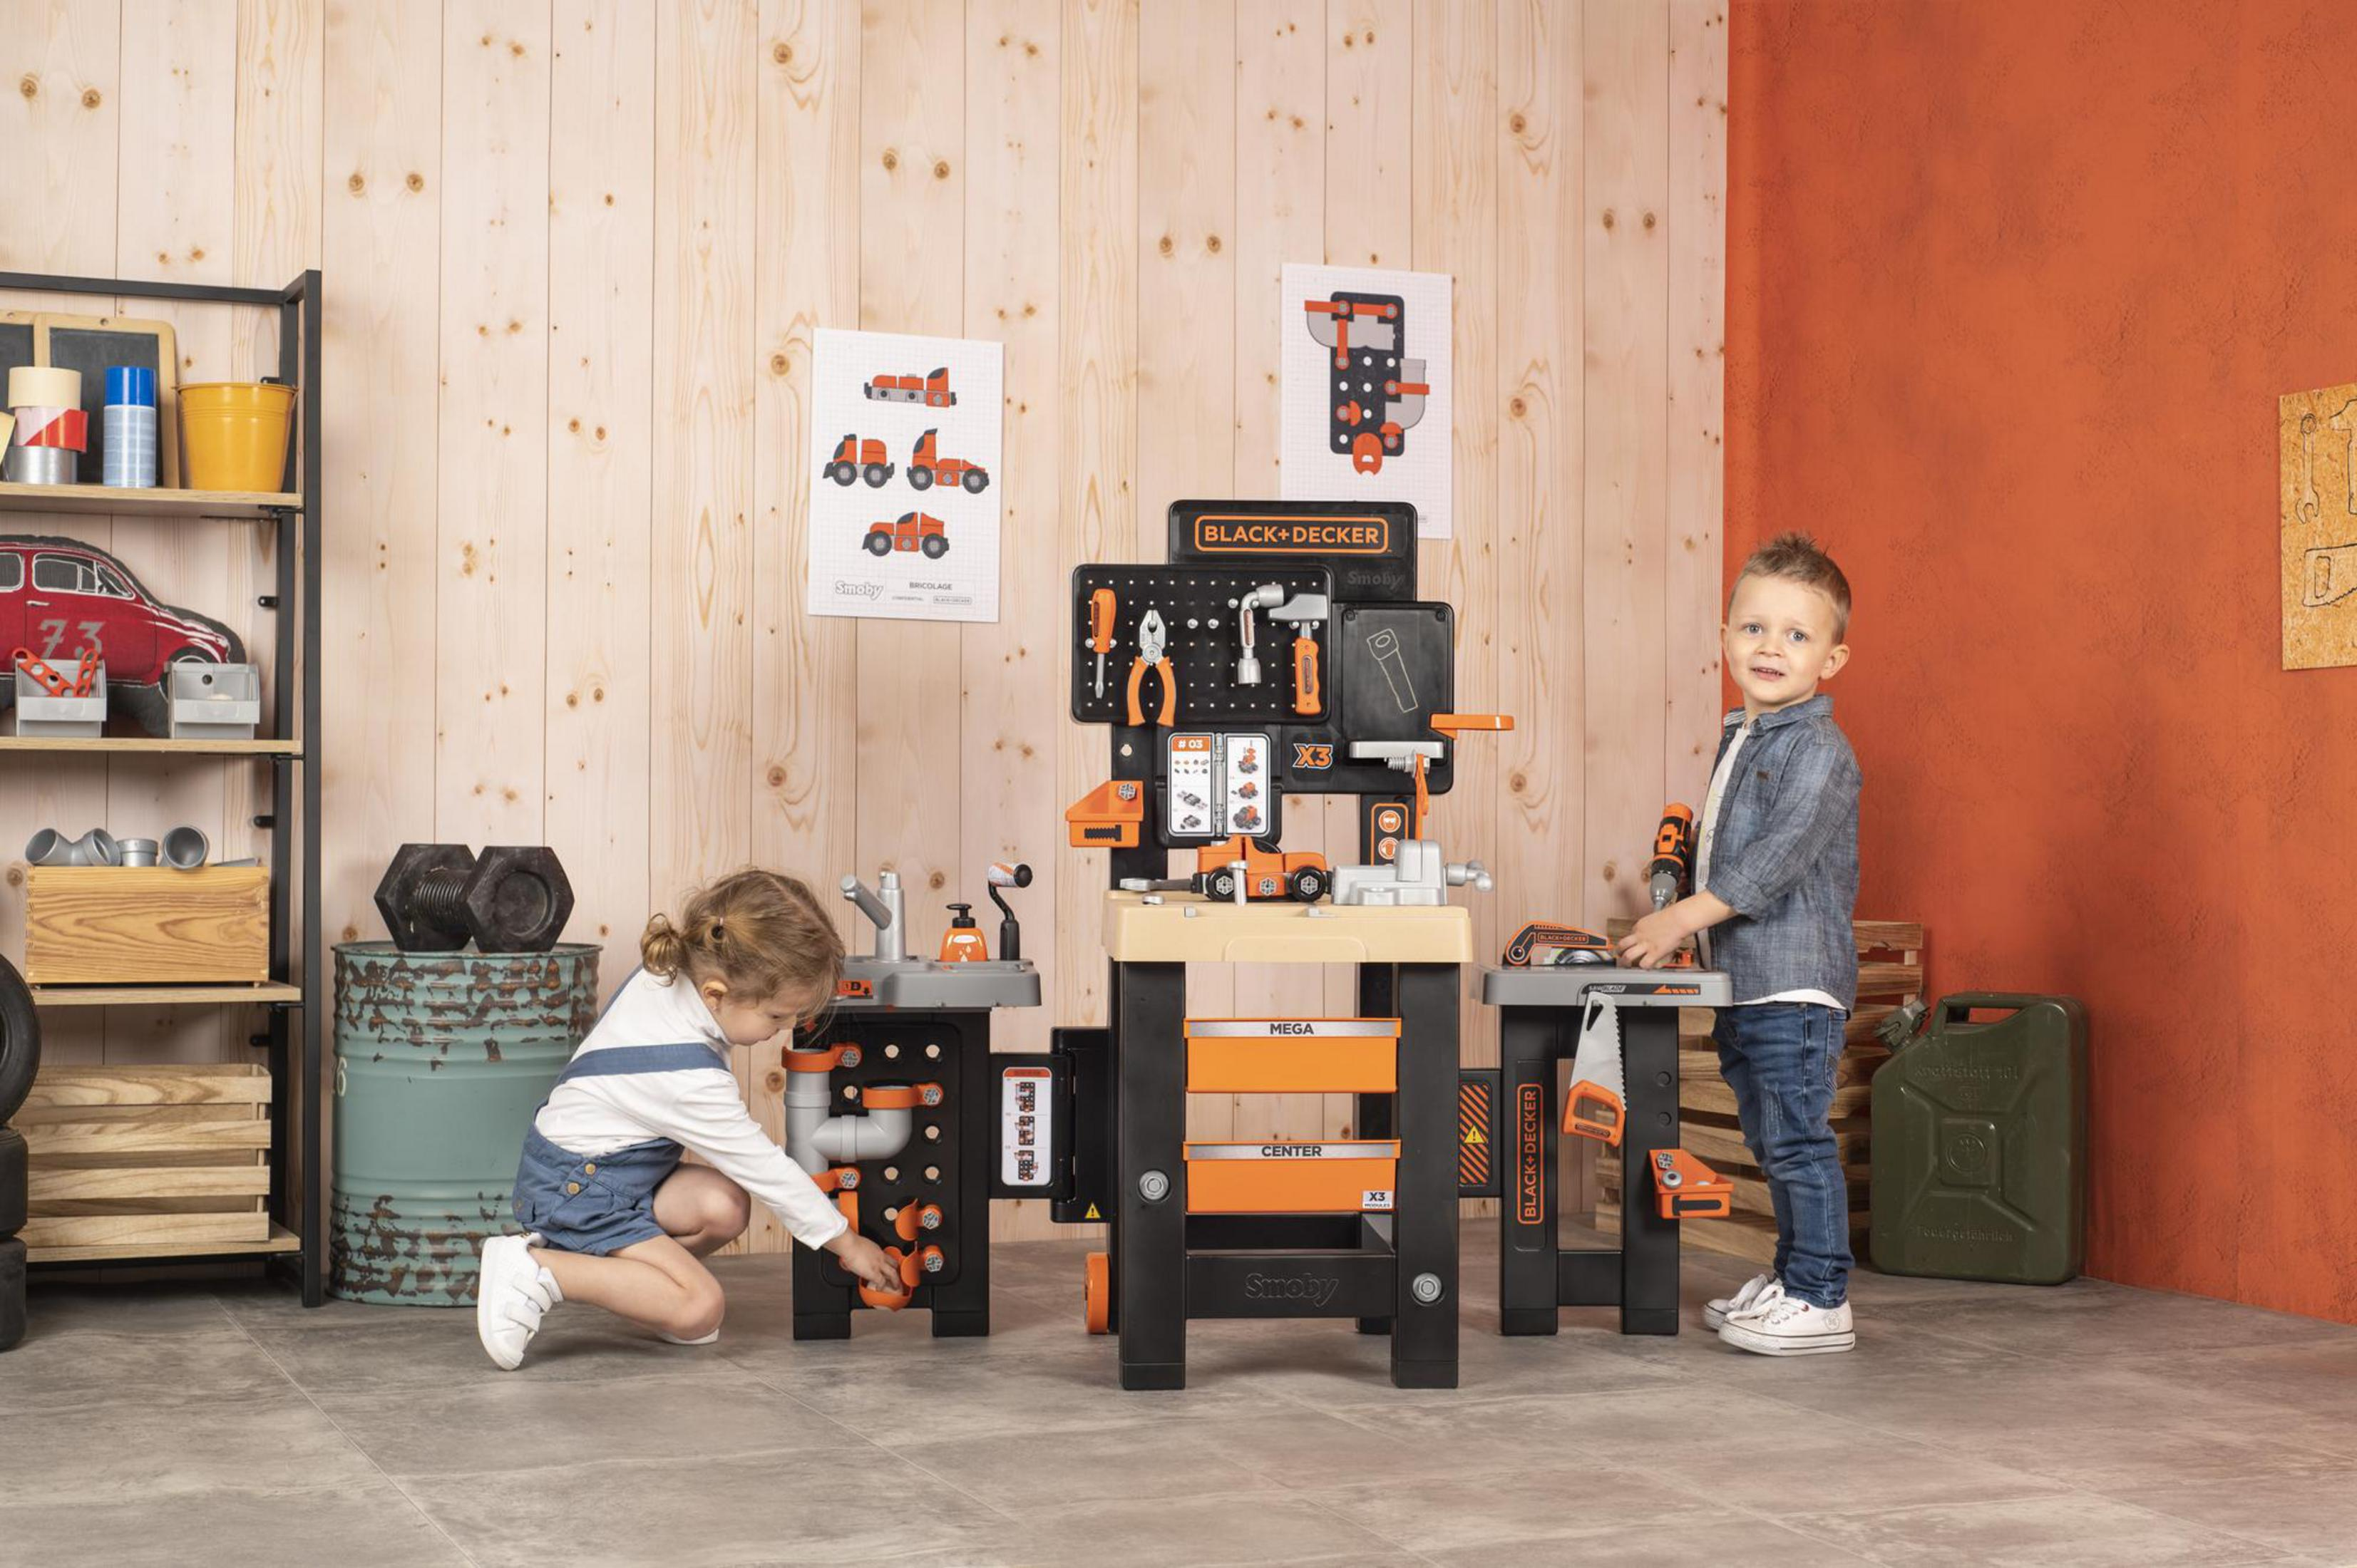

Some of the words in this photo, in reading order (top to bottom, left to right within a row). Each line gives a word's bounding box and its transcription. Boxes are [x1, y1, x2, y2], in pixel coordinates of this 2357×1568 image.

[1204, 525, 1379, 544] BLACK+DECKER
[835, 579, 883, 600] Smoby
[909, 582, 952, 591] BRICOLAGE
[1347, 571, 1405, 591] Smoby
[1295, 745, 1332, 768] X3
[1270, 1023, 1314, 1035] MEGA
[1261, 1145, 1322, 1157] CENTER
[1524, 1090, 1536, 1217] BLACK+DECKER
[1369, 1192, 1385, 1202] X3
[1245, 1272, 1339, 1308] Smoby
